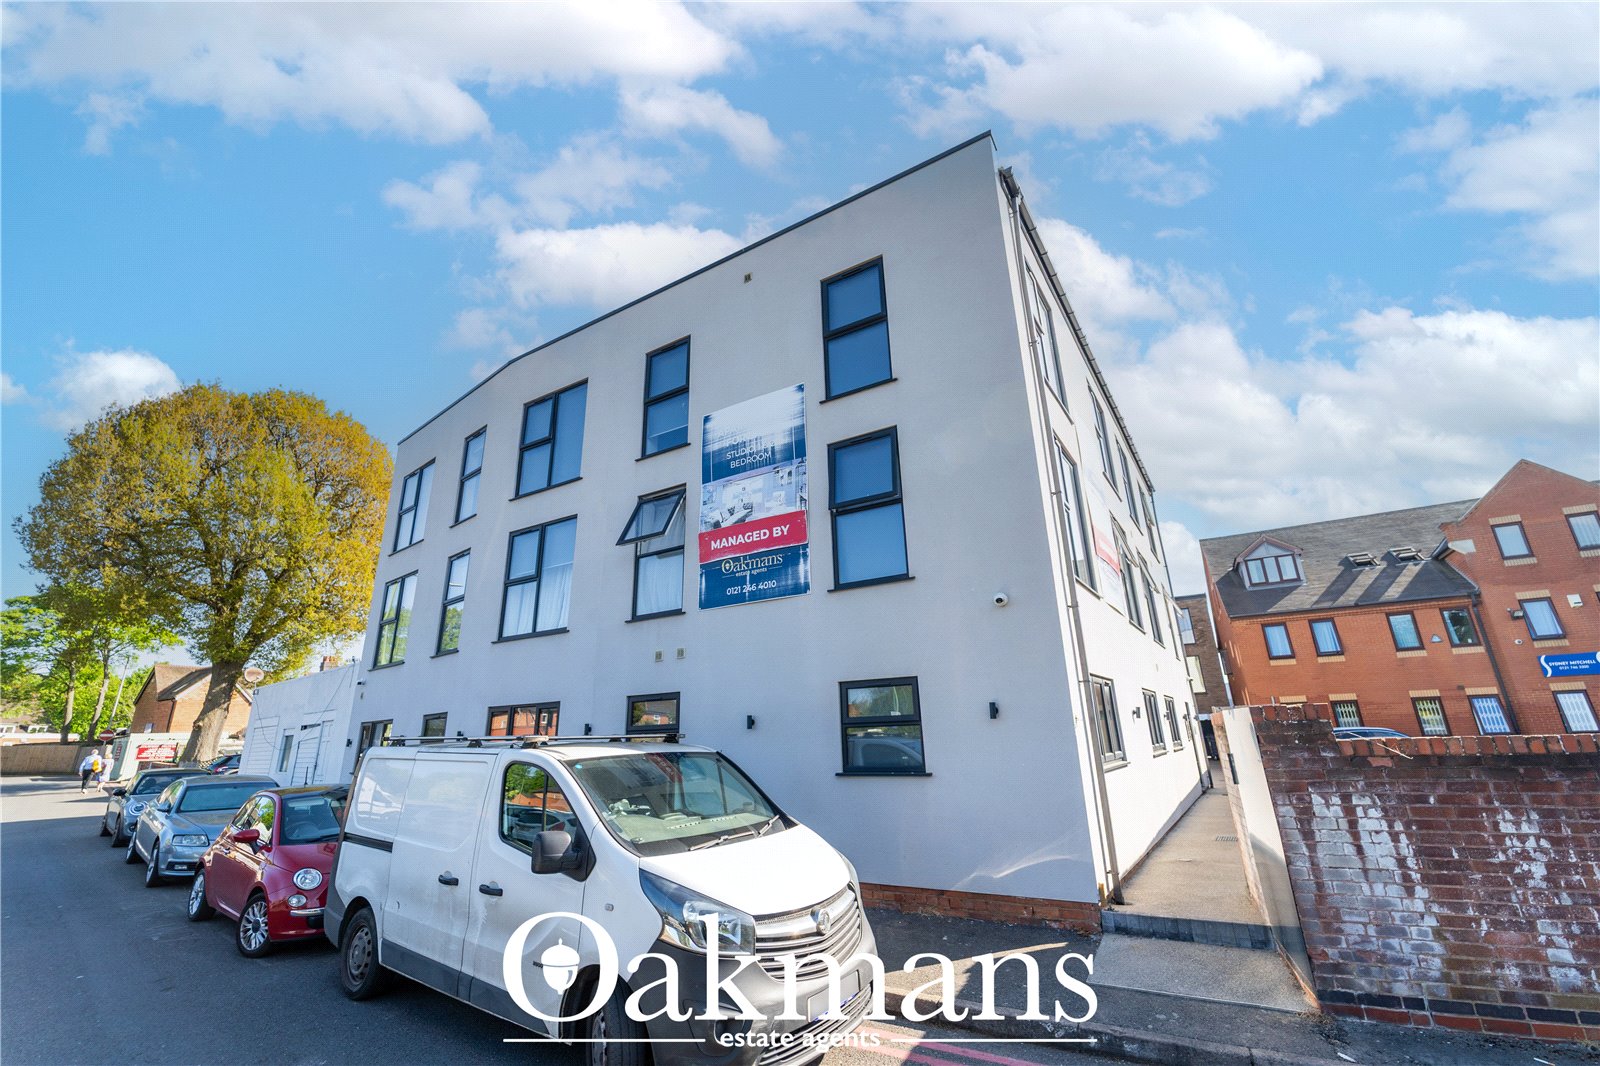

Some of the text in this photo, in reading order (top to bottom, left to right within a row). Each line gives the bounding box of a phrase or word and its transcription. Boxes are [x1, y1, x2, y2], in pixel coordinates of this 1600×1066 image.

[730, 450, 772, 469] BEDROOM
[710, 524, 790, 551] MANAGED BY
[721, 553, 783, 574] Oakmans
[751, 567, 768, 576] agents
[726, 580, 777, 595] 0121 246 4010
